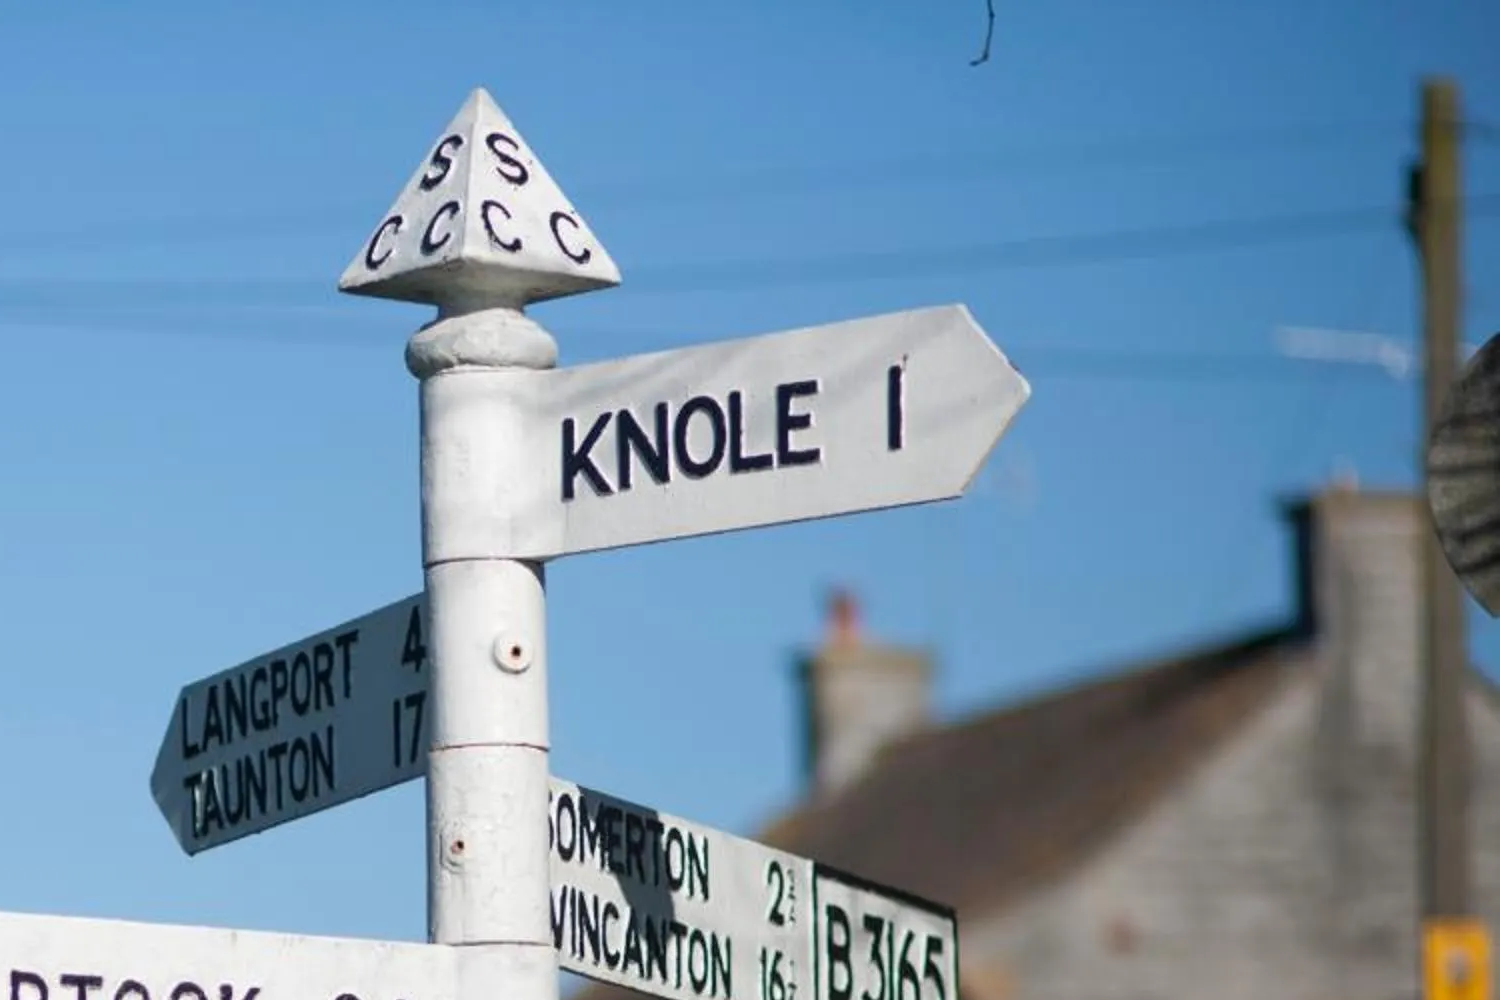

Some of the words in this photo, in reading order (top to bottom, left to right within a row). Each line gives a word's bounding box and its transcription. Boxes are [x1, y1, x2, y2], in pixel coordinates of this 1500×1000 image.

[419, 134, 464, 192] S
[485, 132, 530, 187] S
[561, 380, 821, 501] KNOLE
[181, 629, 360, 760] LANGPORT
[401, 604, 427, 674] 4
[183, 725, 336, 840] TAUNTON
[393, 690, 427, 768] 17
[549, 789, 710, 903] OMERTON
